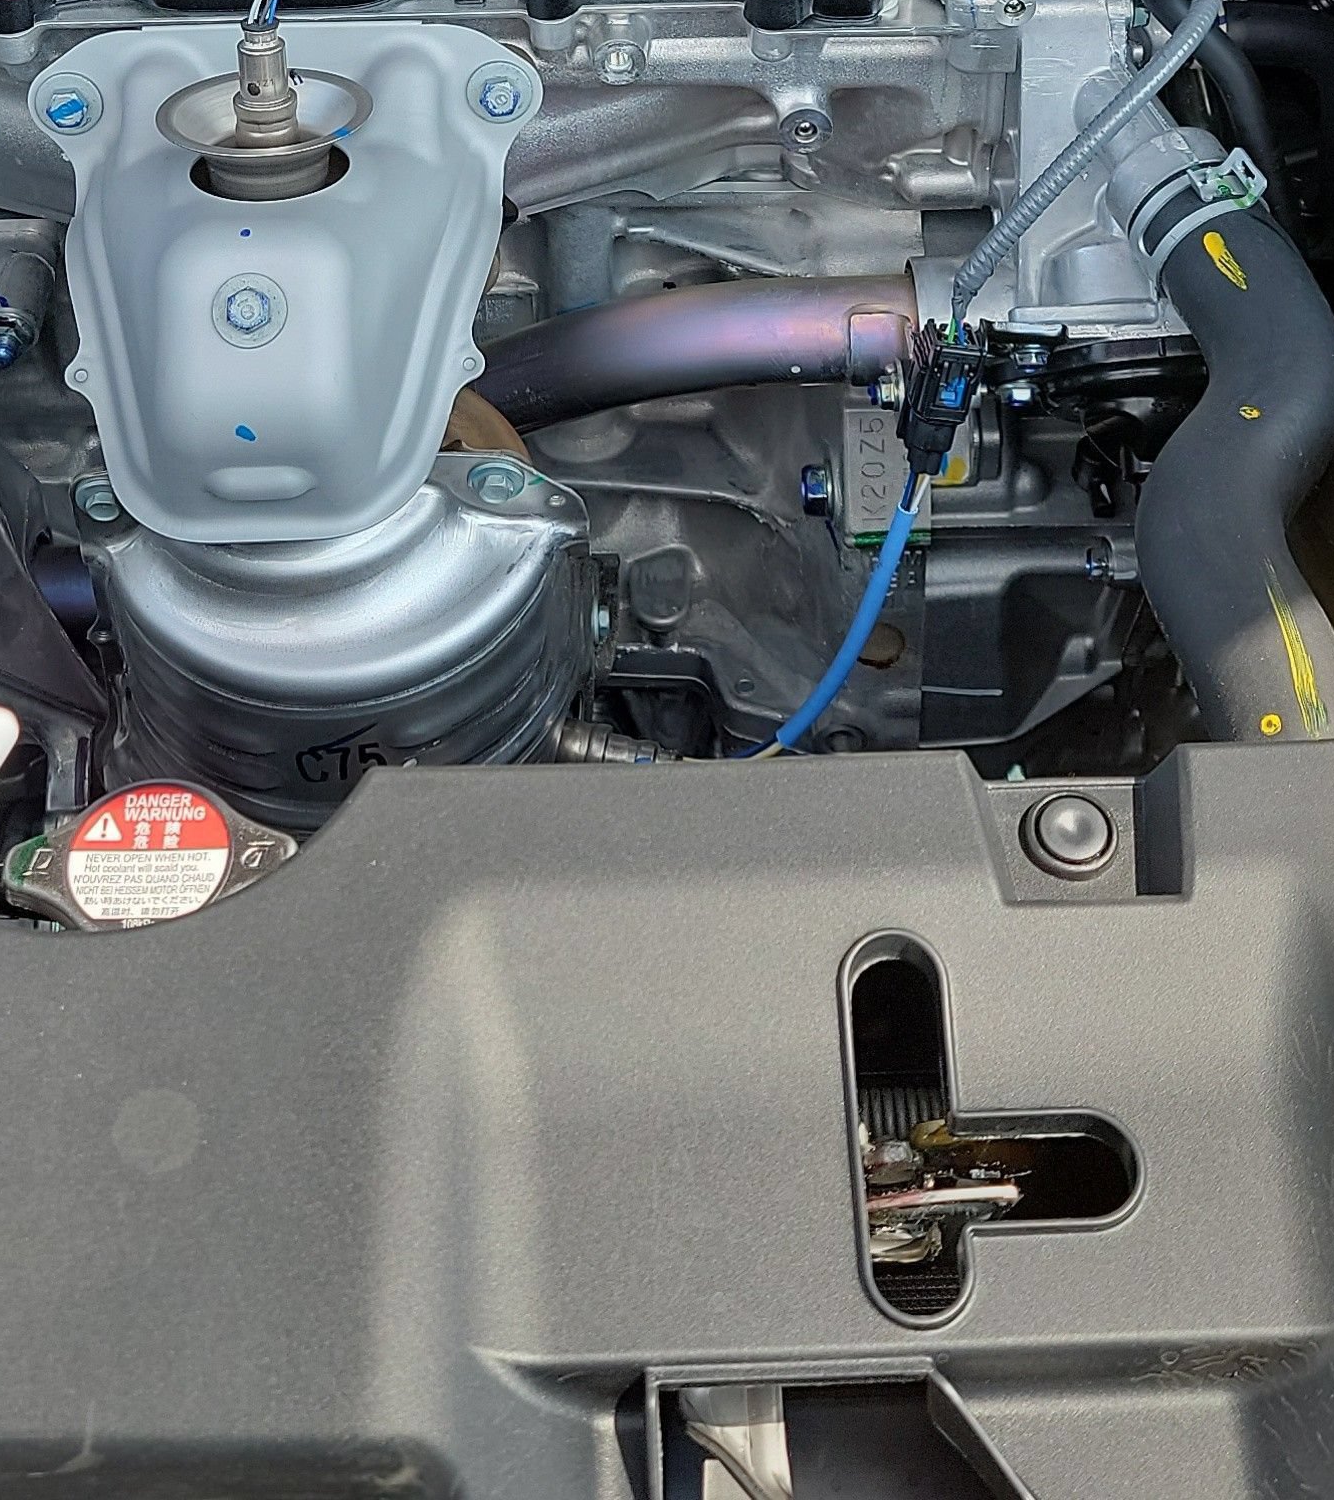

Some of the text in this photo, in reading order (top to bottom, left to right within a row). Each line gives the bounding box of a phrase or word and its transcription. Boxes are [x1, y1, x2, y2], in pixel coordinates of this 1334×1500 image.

[860, 417, 885, 523] K20Z5
[125, 793, 192, 808] DANGER
[124, 806, 206, 821] WARNUNG
[85, 851, 210, 862] NEVER OPEN WHEN HOT.
